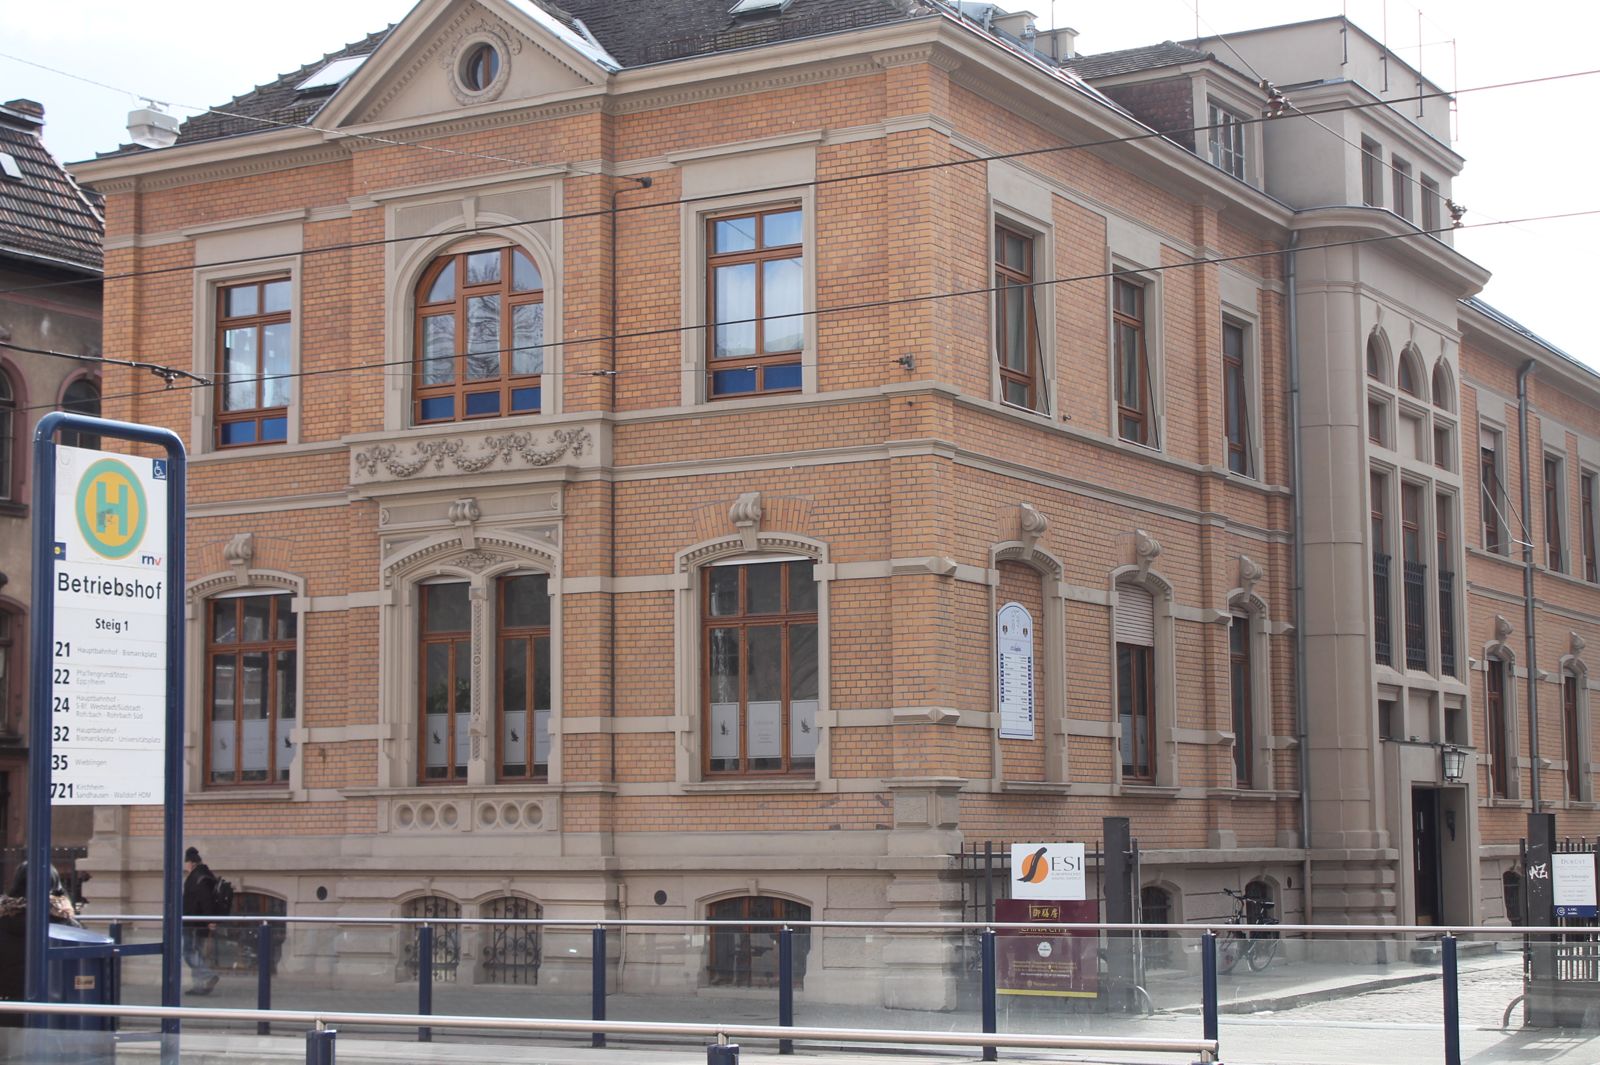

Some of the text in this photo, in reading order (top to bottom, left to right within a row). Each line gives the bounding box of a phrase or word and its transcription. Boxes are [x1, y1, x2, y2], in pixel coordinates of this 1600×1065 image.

[96, 482, 128, 536] H
[141, 554, 162, 566] rnv
[58, 572, 162, 600] Betriebshof
[95, 618, 129, 634] Steig 1
[55, 641, 70, 657] 21
[54, 668, 70, 684] 22
[53, 696, 70, 712] 24
[53, 726, 70, 742] 32
[52, 754, 68, 770] 35
[51, 783, 73, 799] 721
[1051, 856, 1081, 872] ESI
